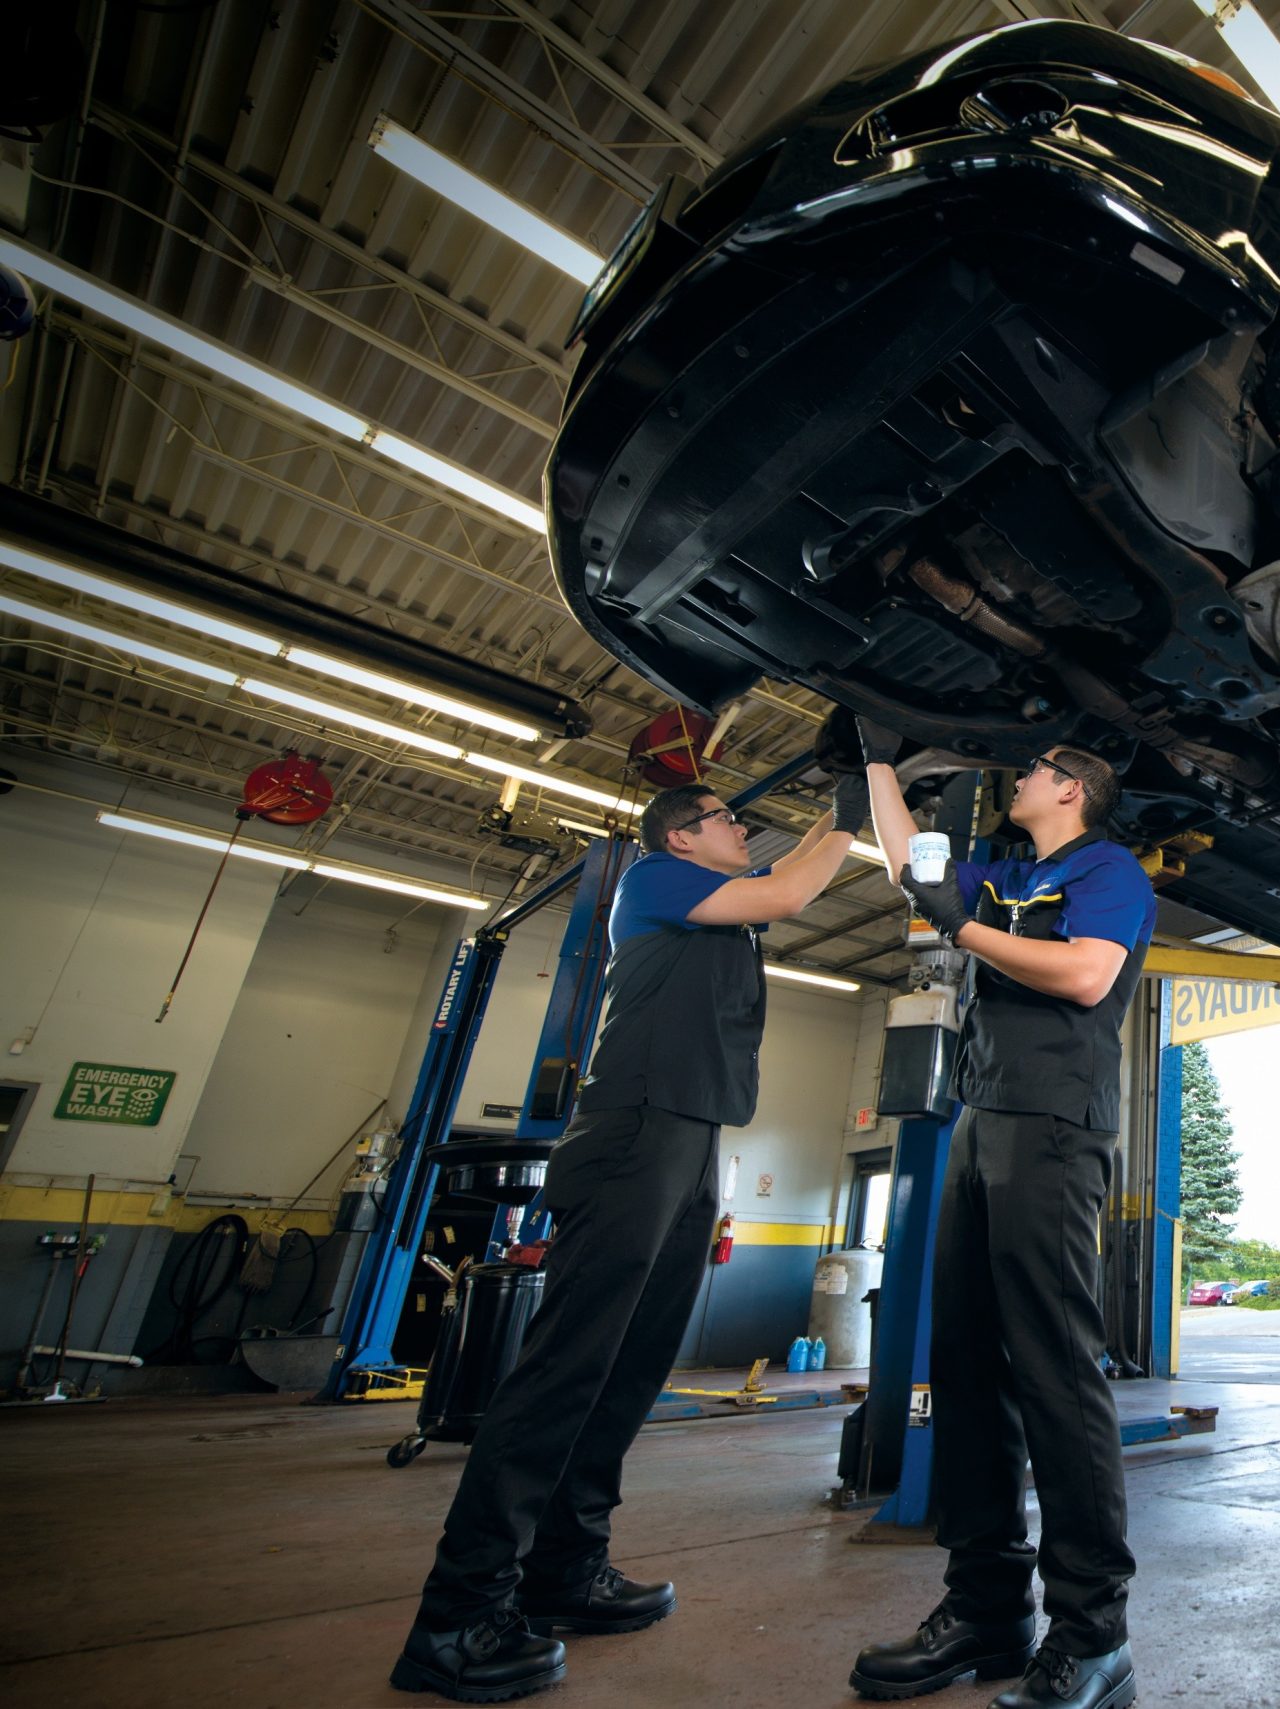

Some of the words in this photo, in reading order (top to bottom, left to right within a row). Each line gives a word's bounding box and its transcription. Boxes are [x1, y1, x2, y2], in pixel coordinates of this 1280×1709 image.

[74, 1067, 169, 1089] EMERGENCY
[69, 1082, 129, 1106] EYE
[66, 1103, 122, 1118] WASH
